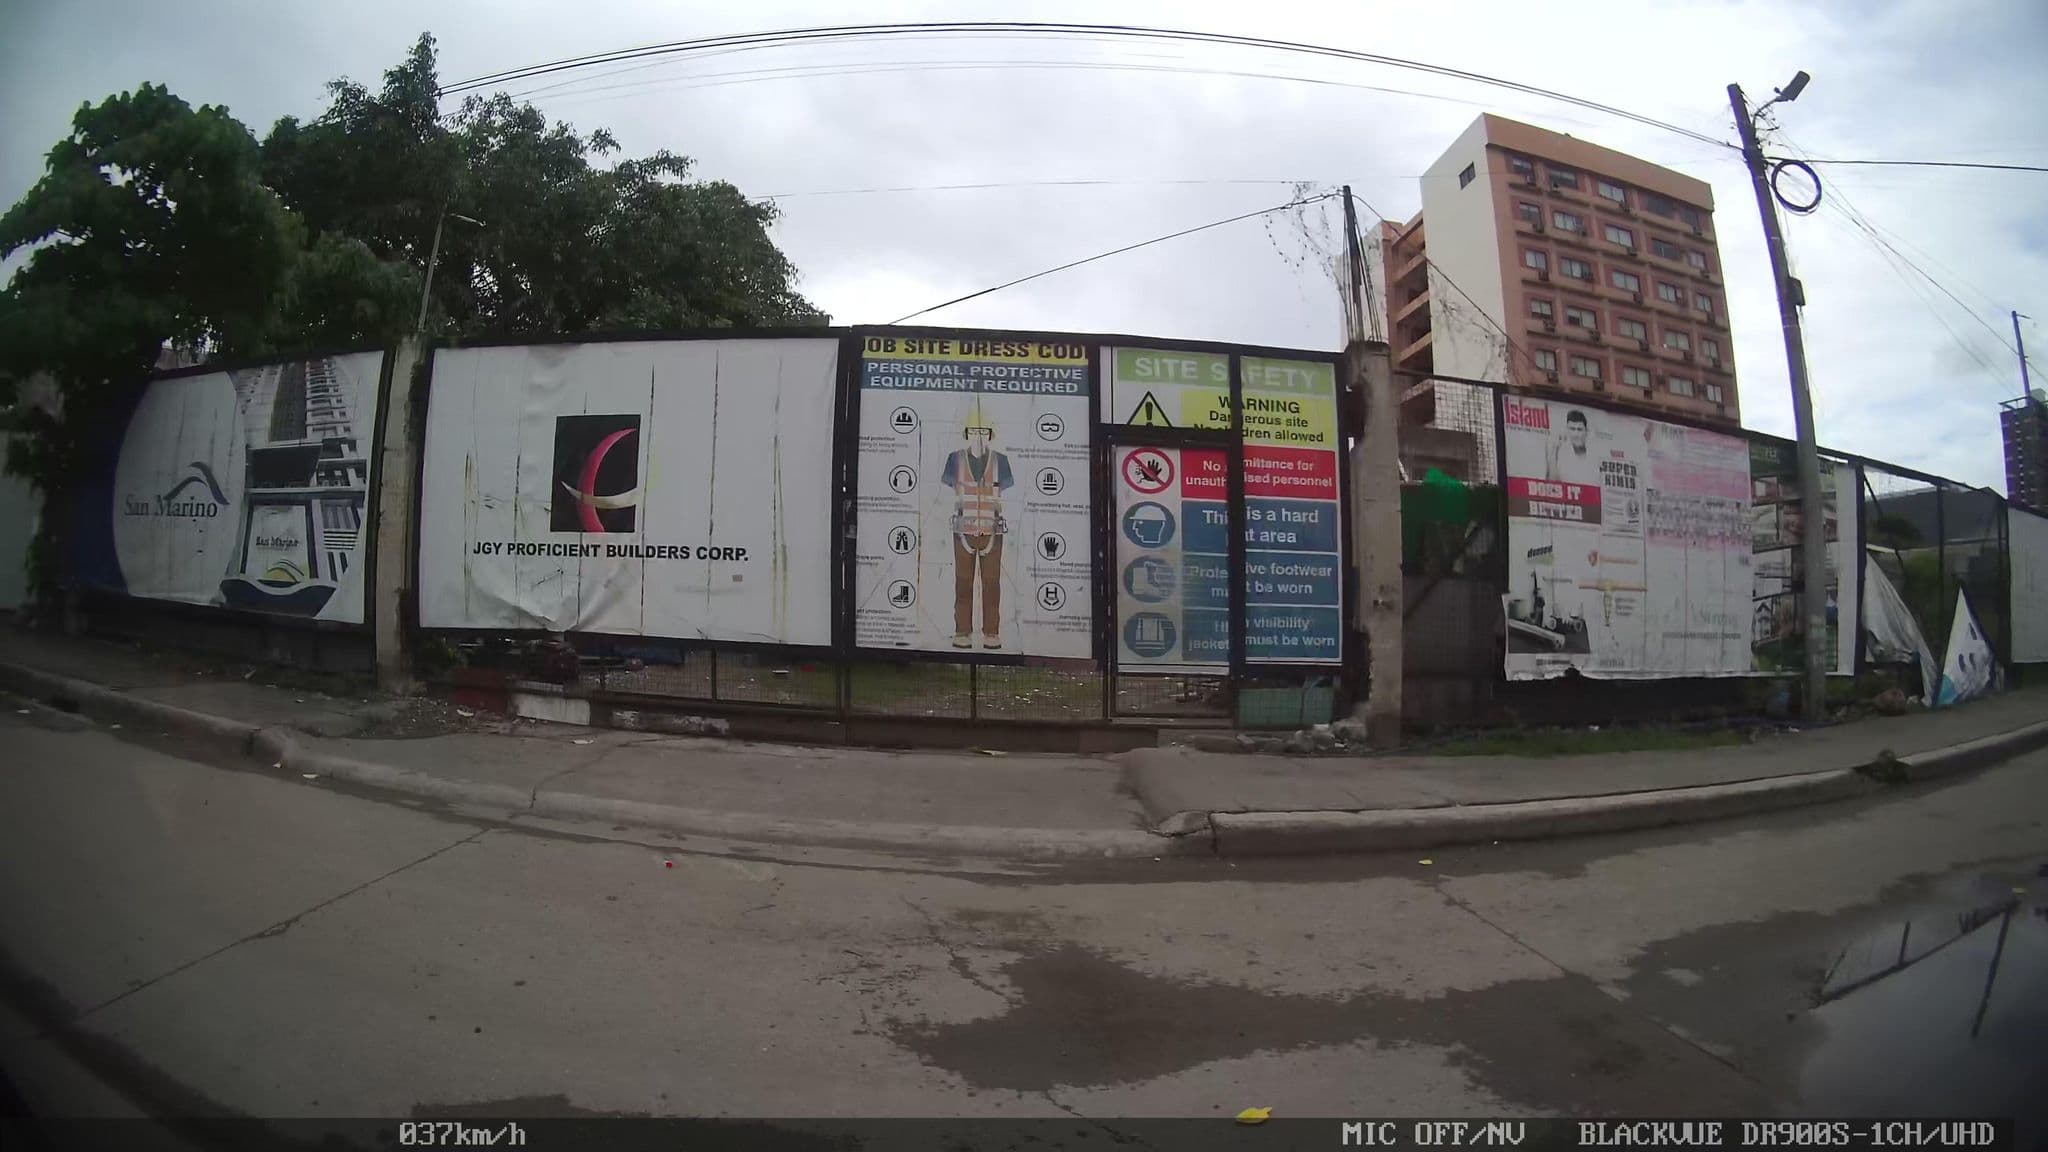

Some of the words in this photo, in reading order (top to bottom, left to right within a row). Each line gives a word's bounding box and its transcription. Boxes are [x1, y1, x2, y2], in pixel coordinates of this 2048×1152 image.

[904, 339, 951, 355] SITE
[959, 341, 1030, 357] DRESS
[867, 362, 964, 376] PERSONAL
[970, 365, 1083, 380] PROTECTIVE
[1135, 357, 1199, 379] SITE
[1210, 361, 1319, 389] SFETY
[870, 375, 978, 390] EQUIPMENT
[983, 379, 1079, 393] REQUIRED
[1218, 396, 1301, 414] WRNING
[1503, 395, 1550, 430] Island
[1209, 410, 1282, 426] Daerous
[1286, 415, 1309, 428] site
[1275, 429, 1325, 443] allowed
[1202, 460, 1222, 472] No
[1226, 458, 1295, 471] mittance
[1297, 460, 1314, 471] for
[1185, 470, 1271, 487] unauthised
[1272, 473, 1333, 488] personnel
[153, 494, 219, 518] Marino
[1202, 509, 1230, 525] Thi
[1246, 506, 1262, 521] is
[1266, 509, 1277, 522] a
[1281, 507, 1320, 523] hard
[1259, 529, 1298, 543] area
[473, 541, 503, 556] JGY
[507, 542, 601, 558] PROFICIENT
[606, 544, 690, 560] BUILDERS
[696, 546, 749, 562] CORP.
[1189, 561, 1265, 580] Proteive
[1270, 561, 1333, 577] footwear
[1254, 580, 1274, 594] be
[1278, 581, 1314, 595] worn
[1253, 615, 1311, 632] visibility
[1245, 634, 1278, 646] must
[1282, 633, 1299, 646] be
[1302, 635, 1336, 647] worn
